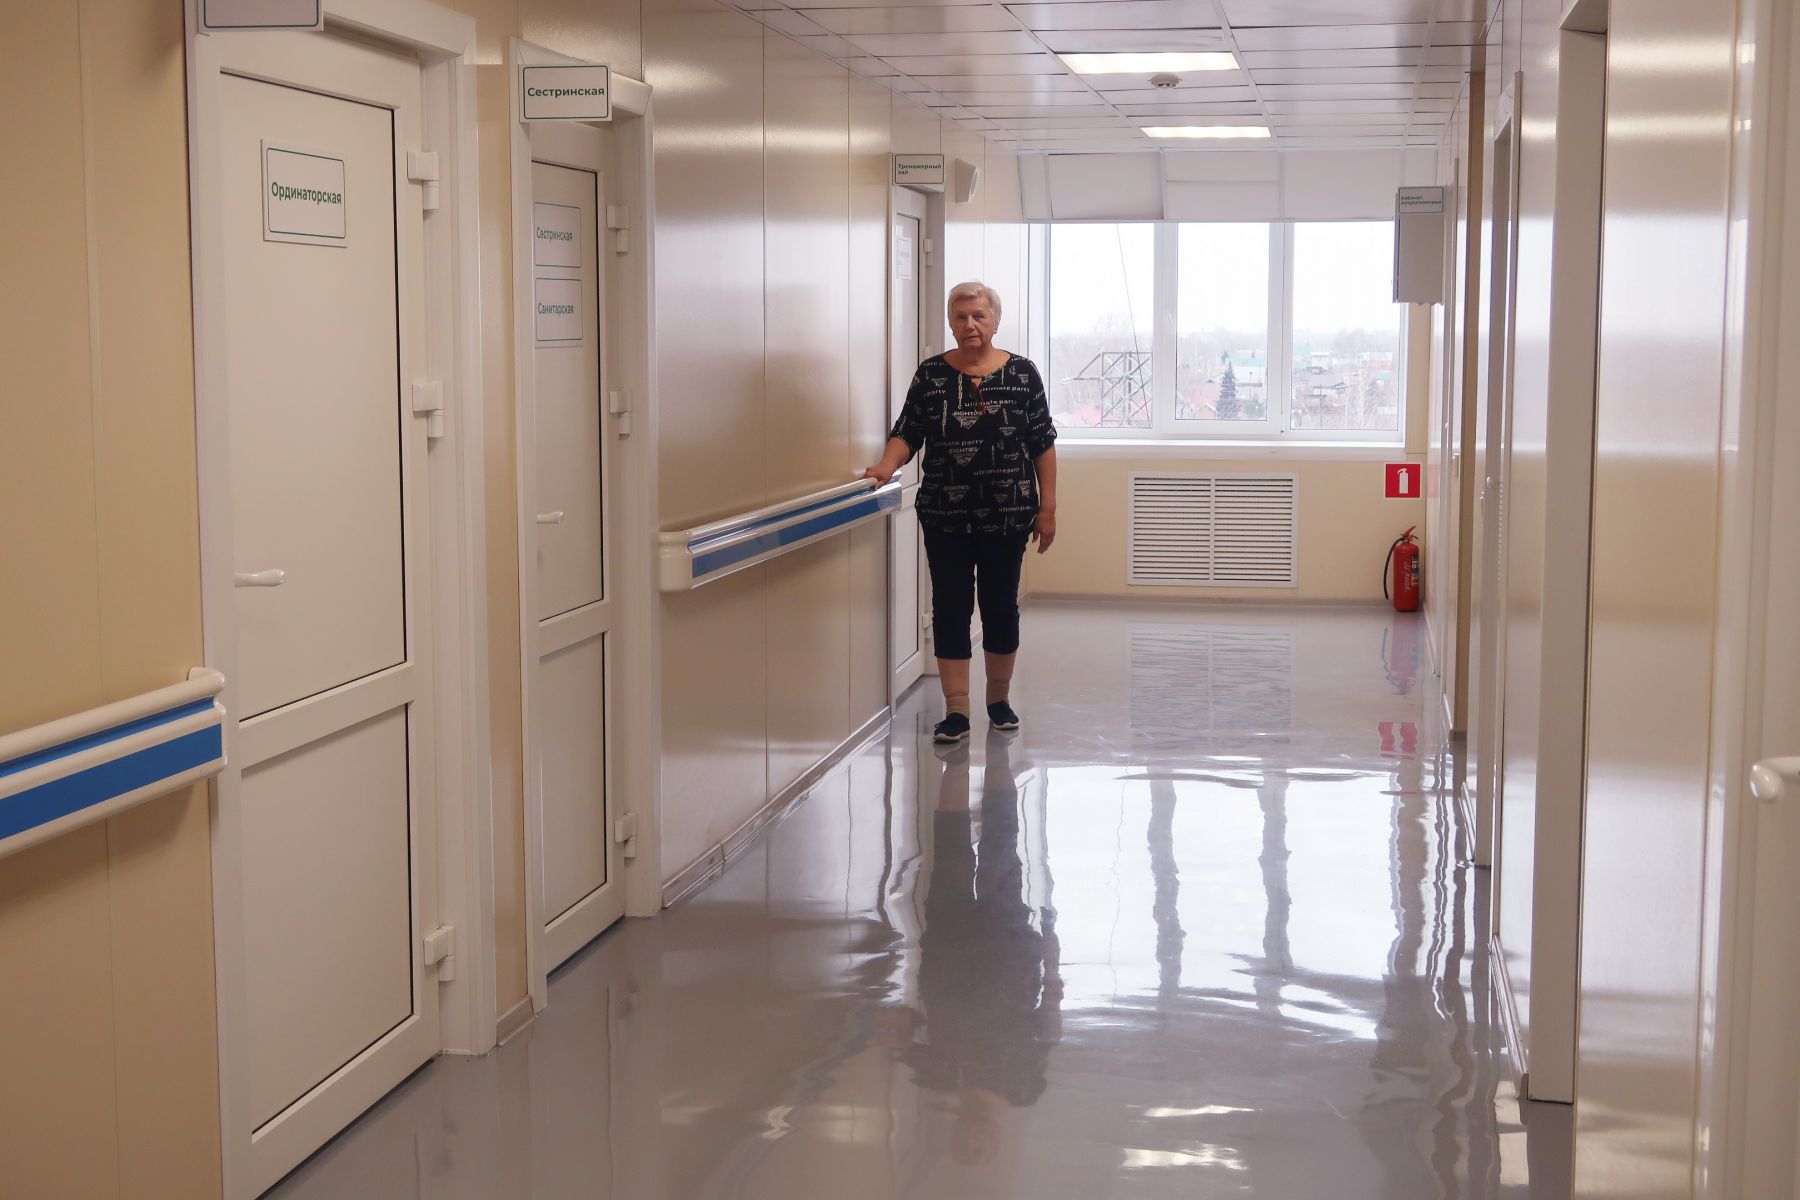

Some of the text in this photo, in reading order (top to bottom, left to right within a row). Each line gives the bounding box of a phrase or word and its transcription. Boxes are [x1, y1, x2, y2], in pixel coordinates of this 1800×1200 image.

[527, 87, 605, 98] Сестринская
[271, 181, 342, 205] Ординаторская
[536, 227, 573, 242] Сестринская
[538, 302, 574, 316] Санитарская
